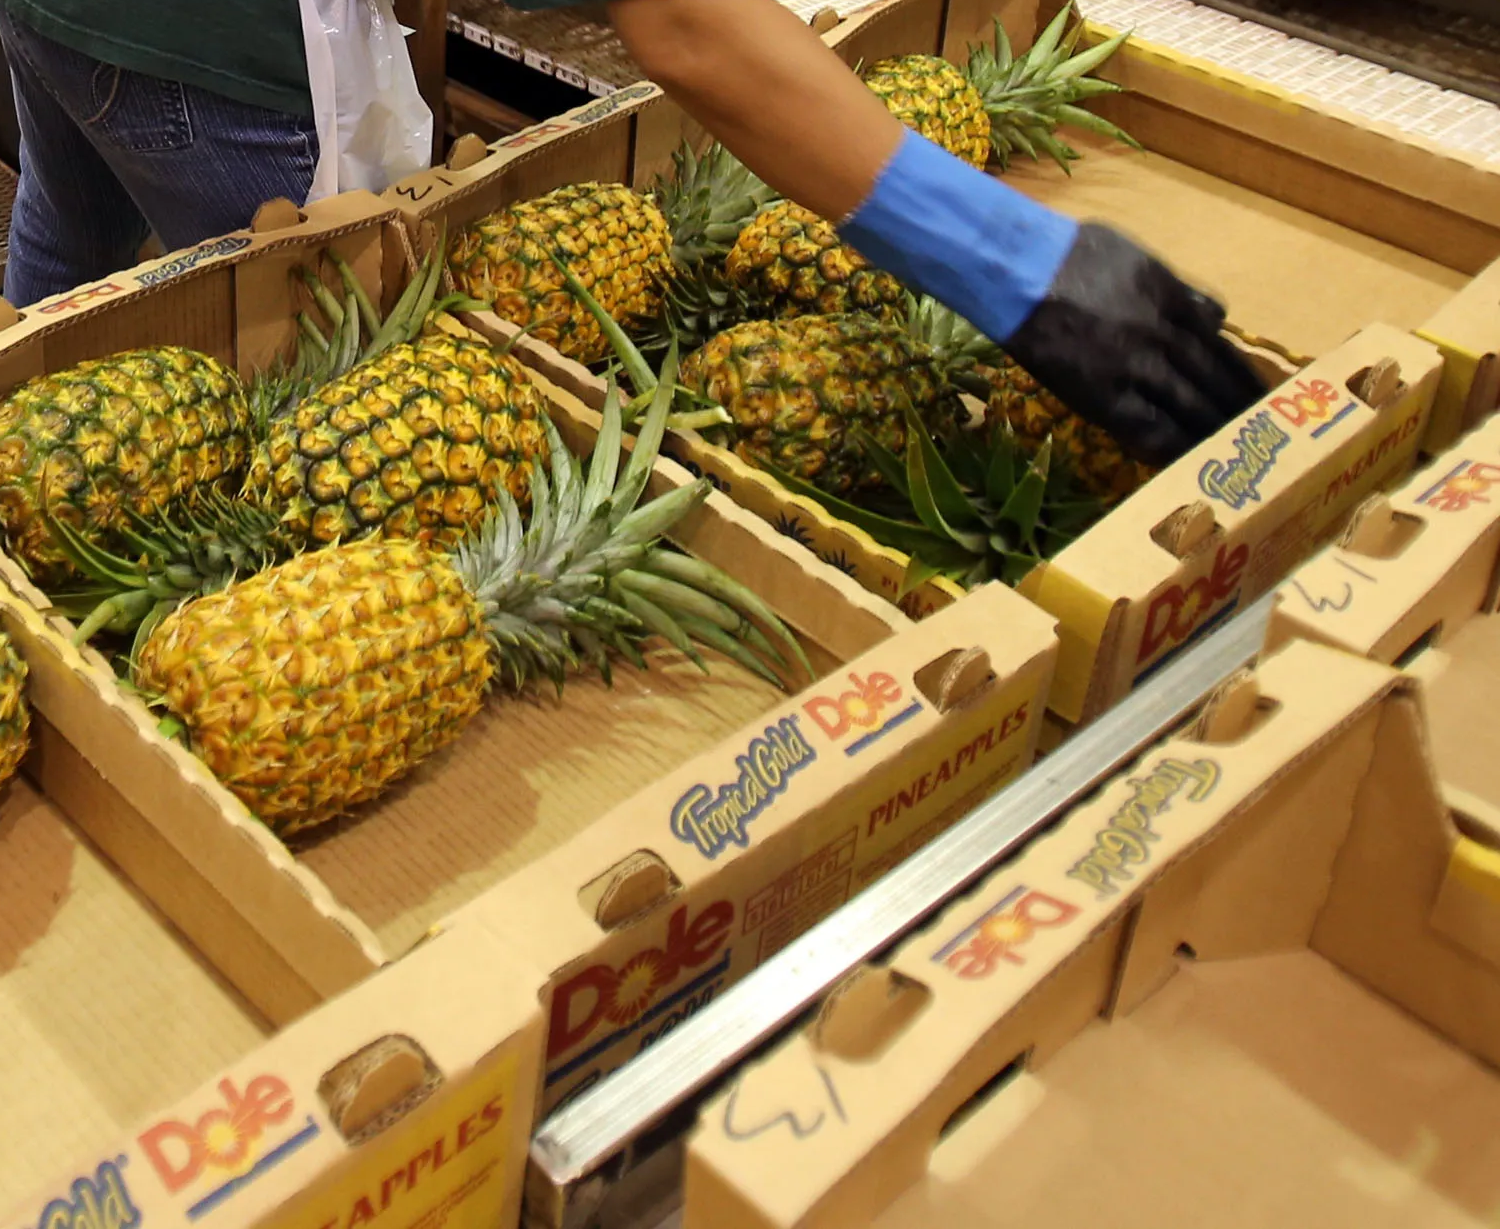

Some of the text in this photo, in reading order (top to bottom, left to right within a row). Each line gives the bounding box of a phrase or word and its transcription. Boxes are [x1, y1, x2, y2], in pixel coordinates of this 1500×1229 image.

[1268, 379, 1340, 428] Dole
[1136, 543, 1250, 666] Dole
[670, 670, 903, 860] Tropical Gold Dole
[866, 701, 1029, 839] PINEAPPLES
[546, 899, 736, 1061] Dole
[943, 889, 1085, 983] Dole
[136, 1073, 295, 1198] Dole
